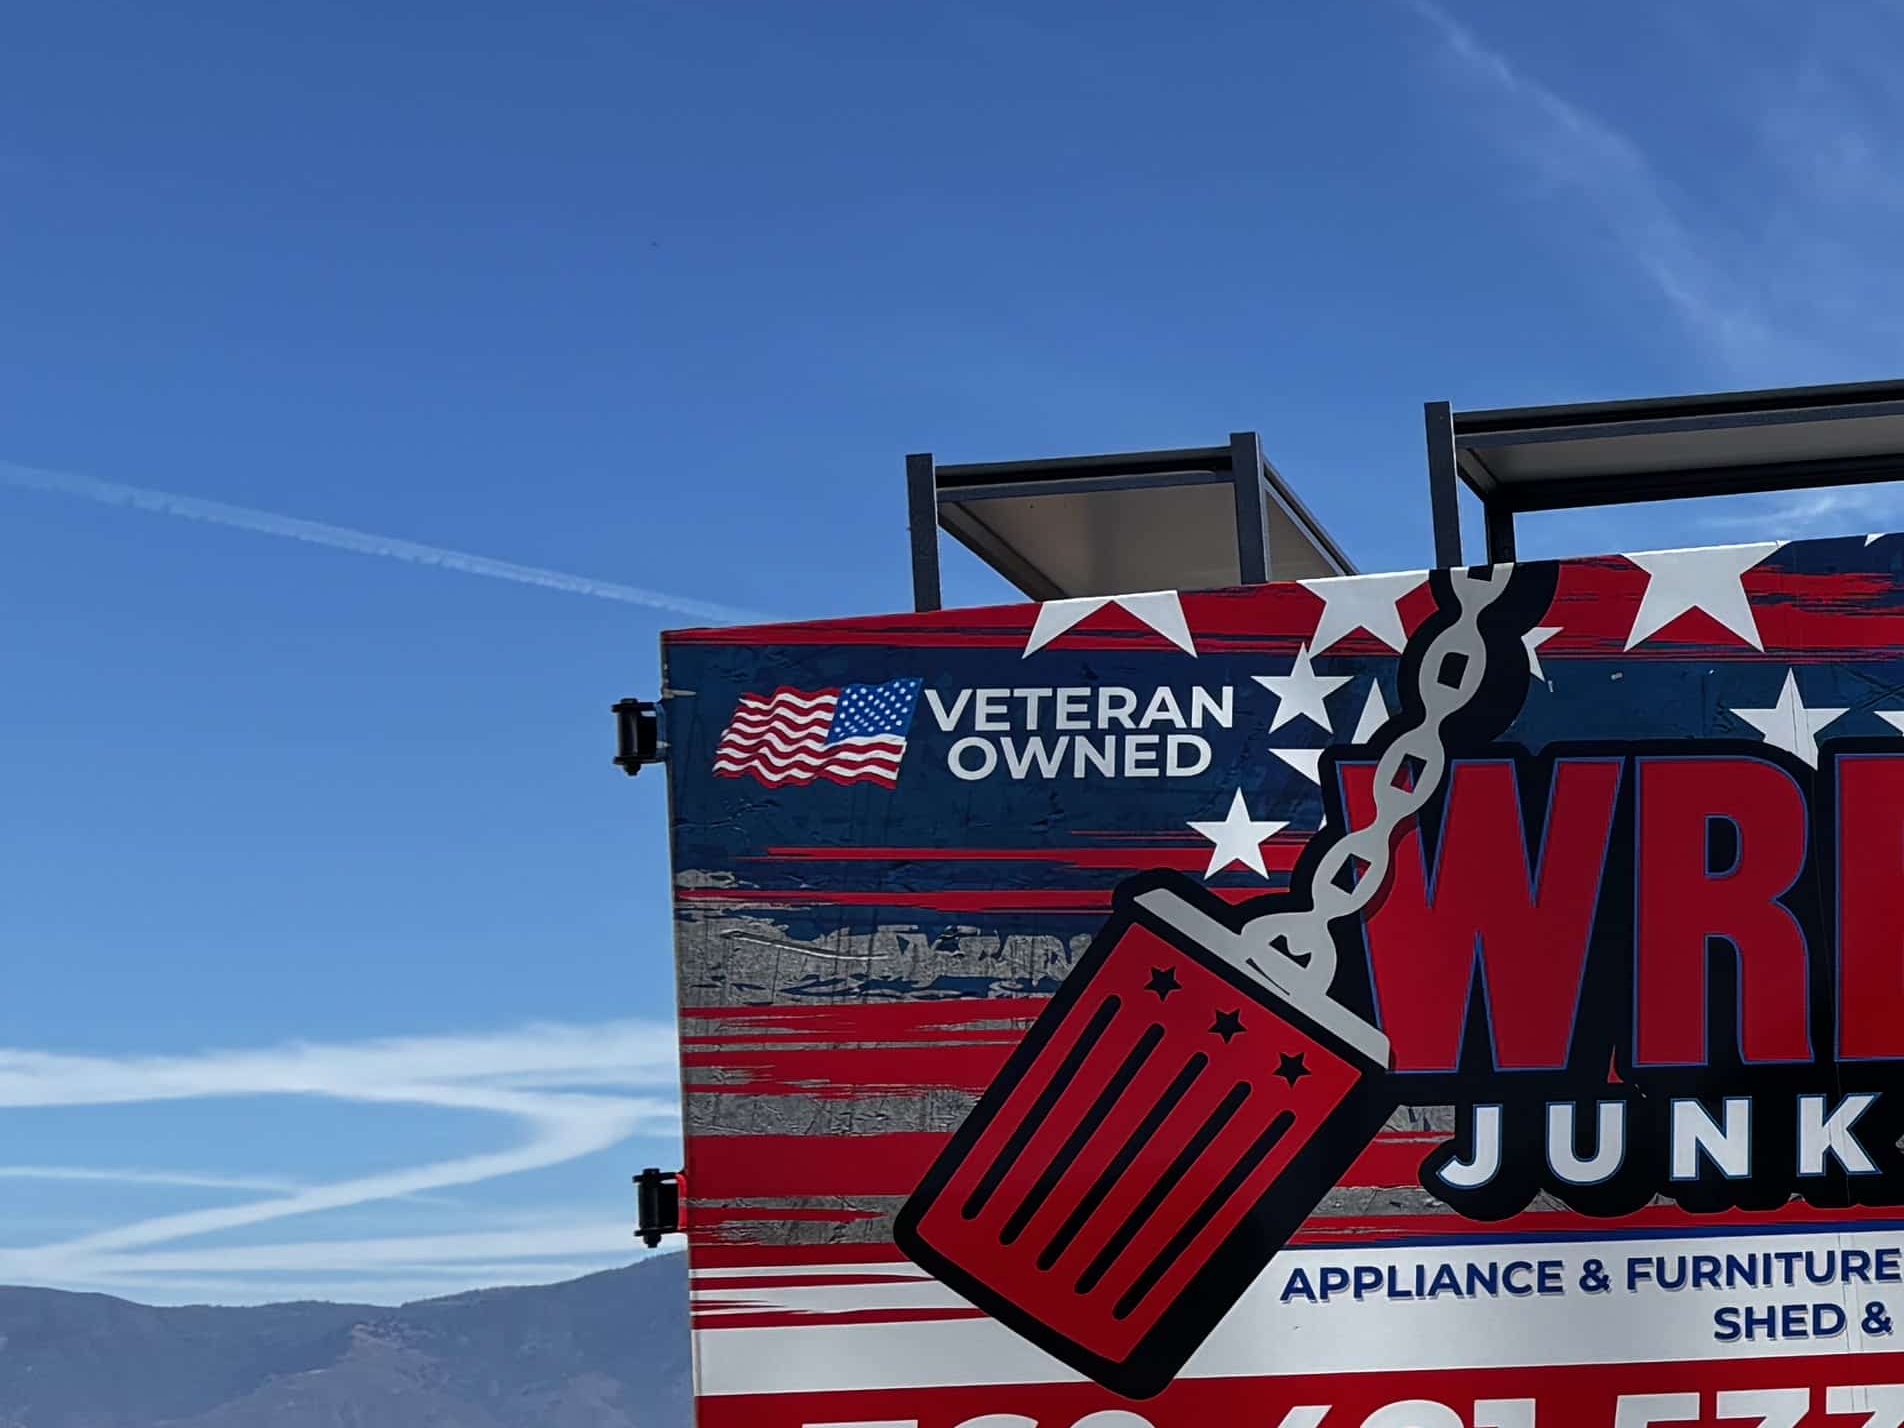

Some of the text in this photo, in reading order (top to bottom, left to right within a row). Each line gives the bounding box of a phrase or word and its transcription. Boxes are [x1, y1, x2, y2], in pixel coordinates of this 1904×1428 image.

[924, 685, 1234, 732] VETERAN
[946, 733, 1212, 781] OWNED
[1438, 1093, 1882, 1188] JUNK
[1280, 1259, 1563, 1302] APPLIANCE
[1579, 1258, 1611, 1291] &
[1626, 1247, 1902, 1291] FURNITURE
[1713, 1303, 1847, 1342] SHED
[1861, 1303, 1894, 1337] &
